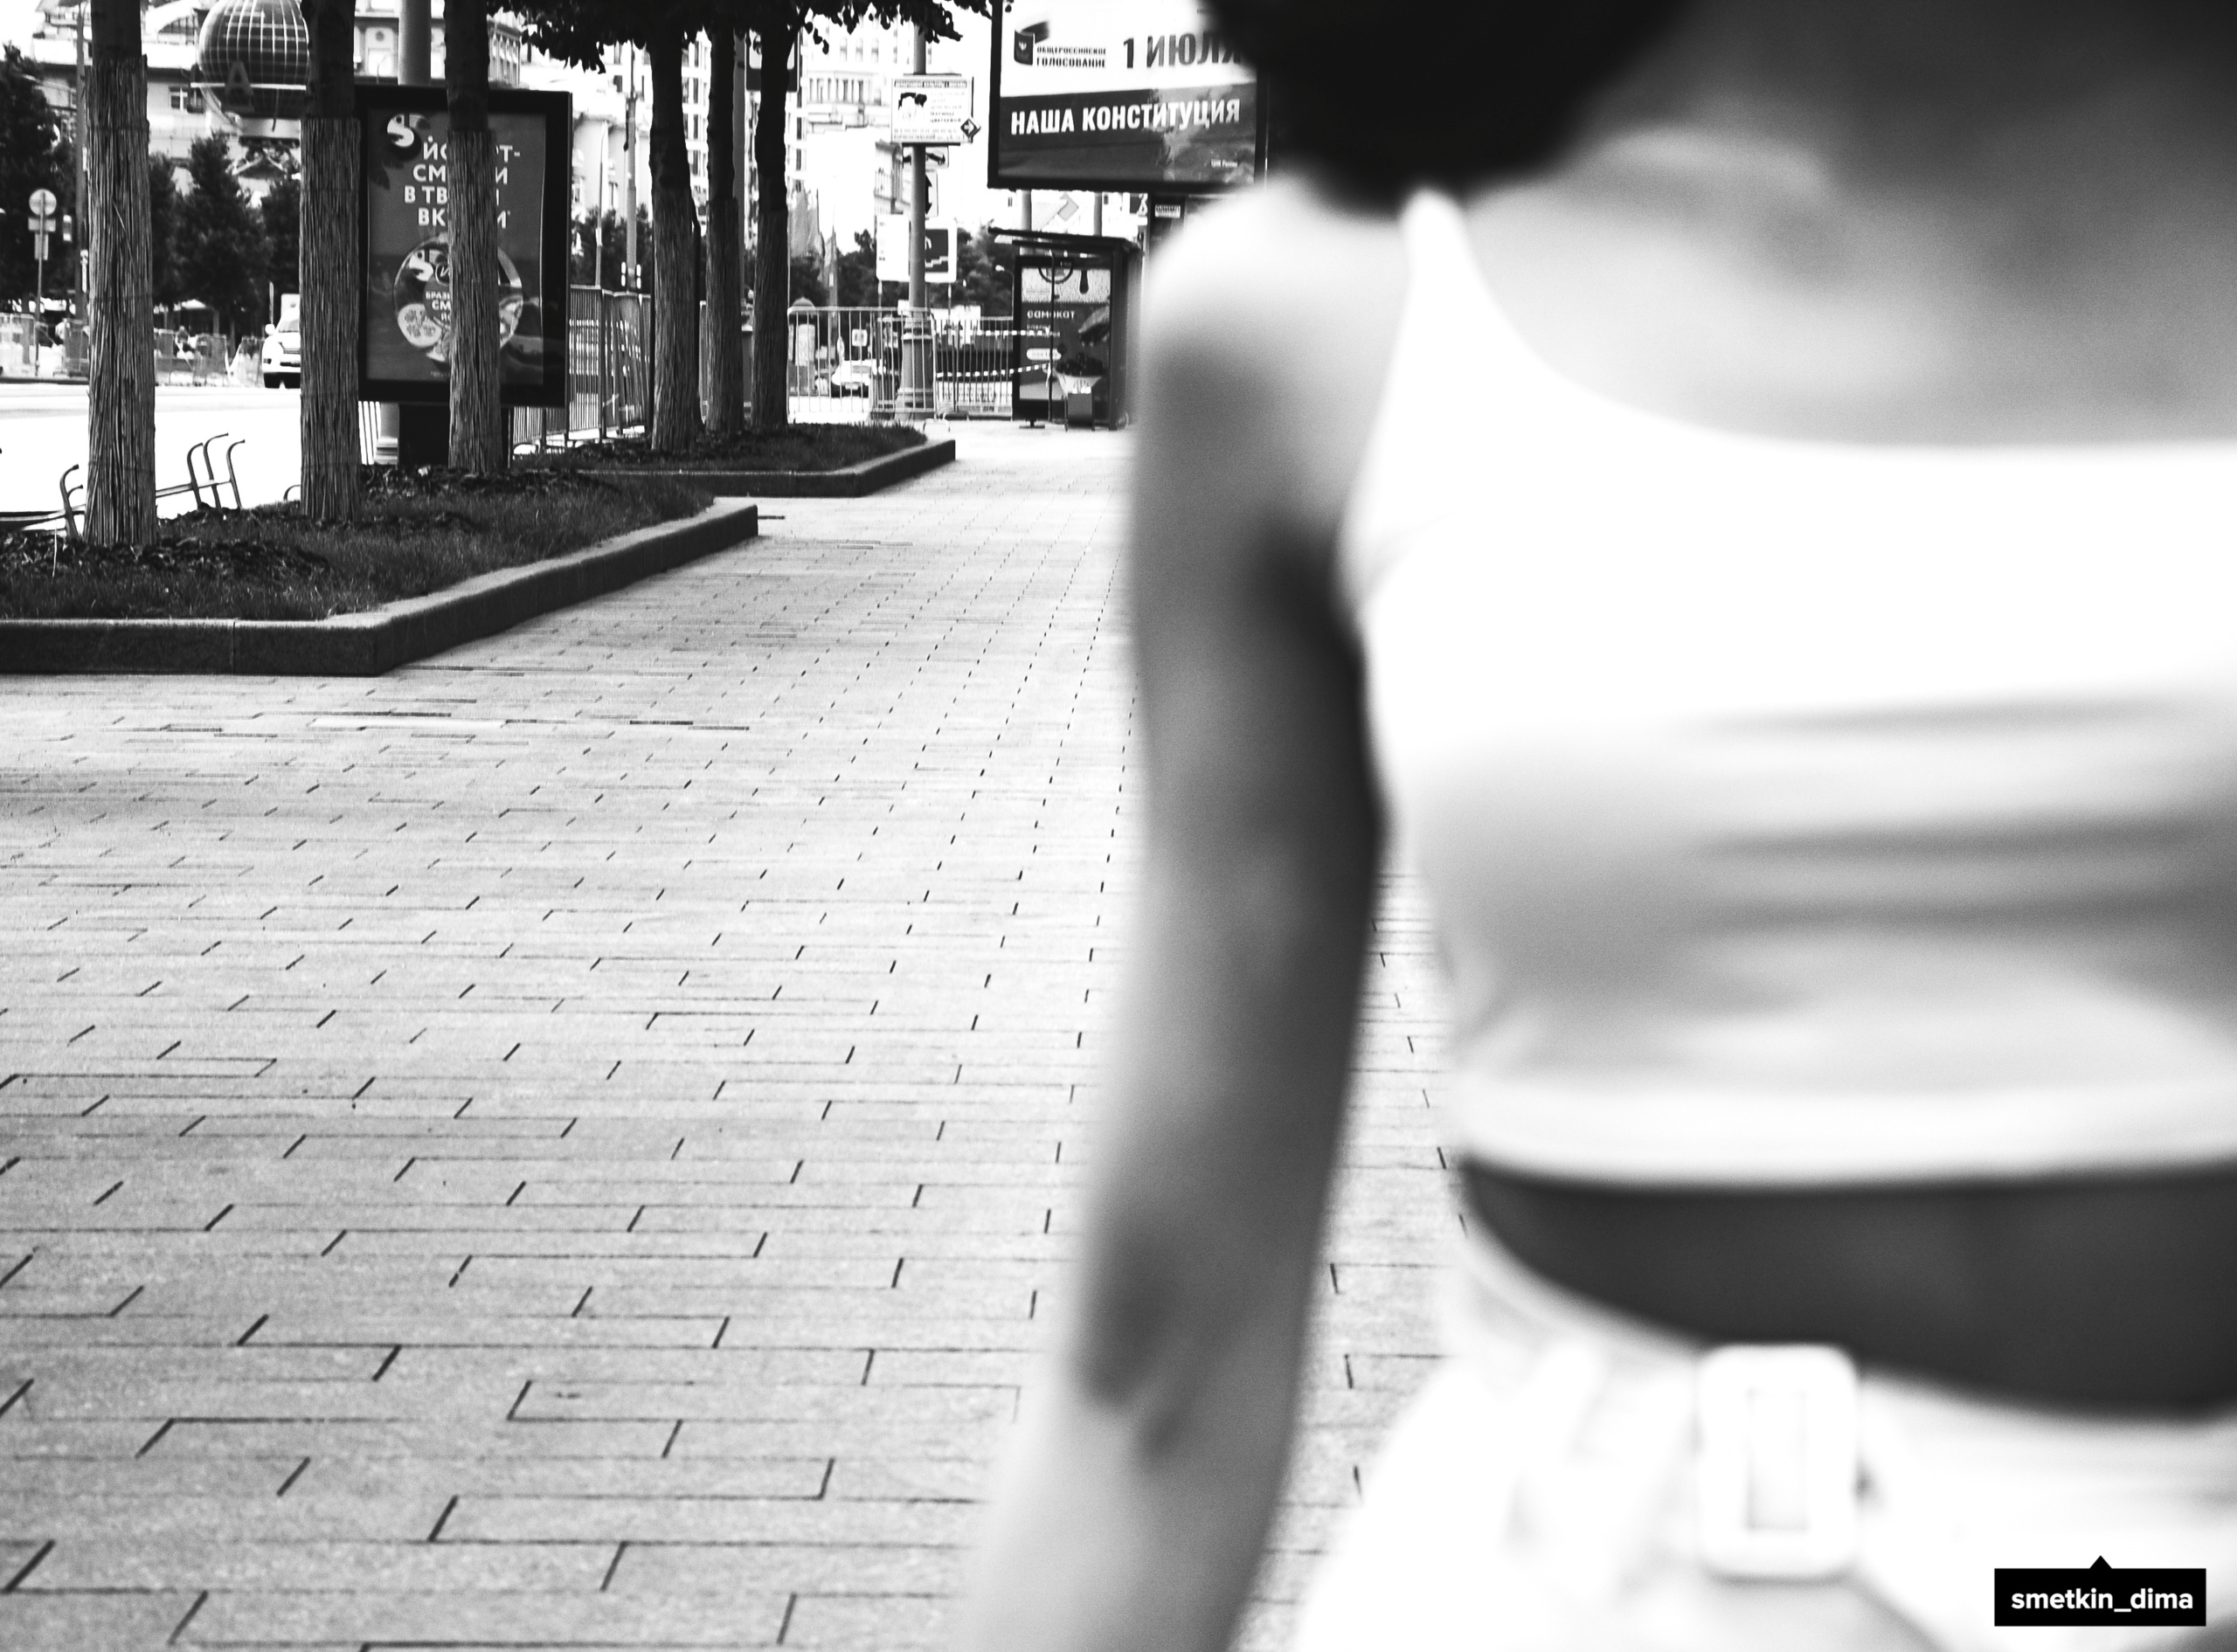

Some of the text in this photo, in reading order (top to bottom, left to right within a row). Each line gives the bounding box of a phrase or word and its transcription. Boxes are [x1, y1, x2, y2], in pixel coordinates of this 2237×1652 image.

[1036, 57, 1105, 68] ГОЛОСОВАНИЕ
[1123, 38, 1134, 69] 1
[1010, 98, 1241, 135] НАША КОНСТИТУЦИЯ
[412, 163, 508, 184] СМИ
[404, 184, 416, 204] В
